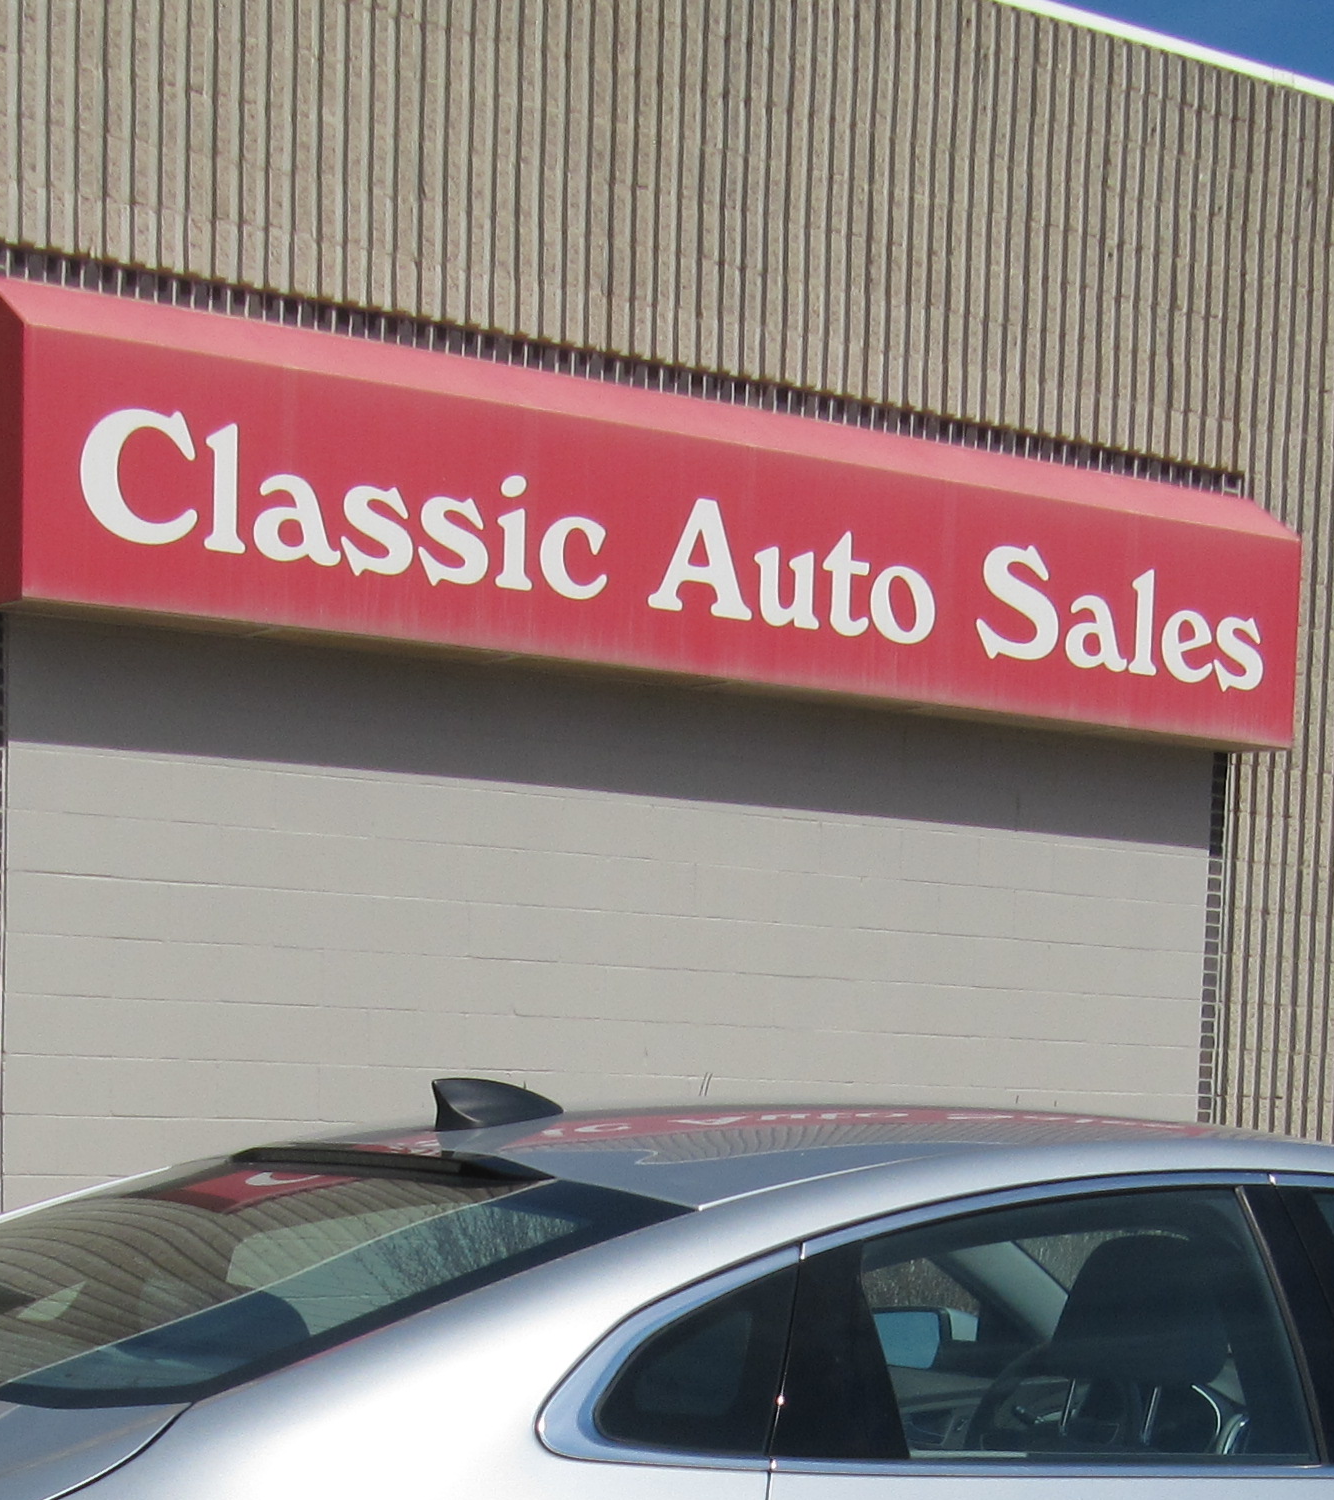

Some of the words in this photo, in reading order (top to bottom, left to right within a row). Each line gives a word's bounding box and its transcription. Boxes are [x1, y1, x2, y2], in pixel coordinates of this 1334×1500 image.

[79, 407, 608, 600] Classic
[646, 497, 937, 645] Auto
[975, 544, 1265, 693] Sales
